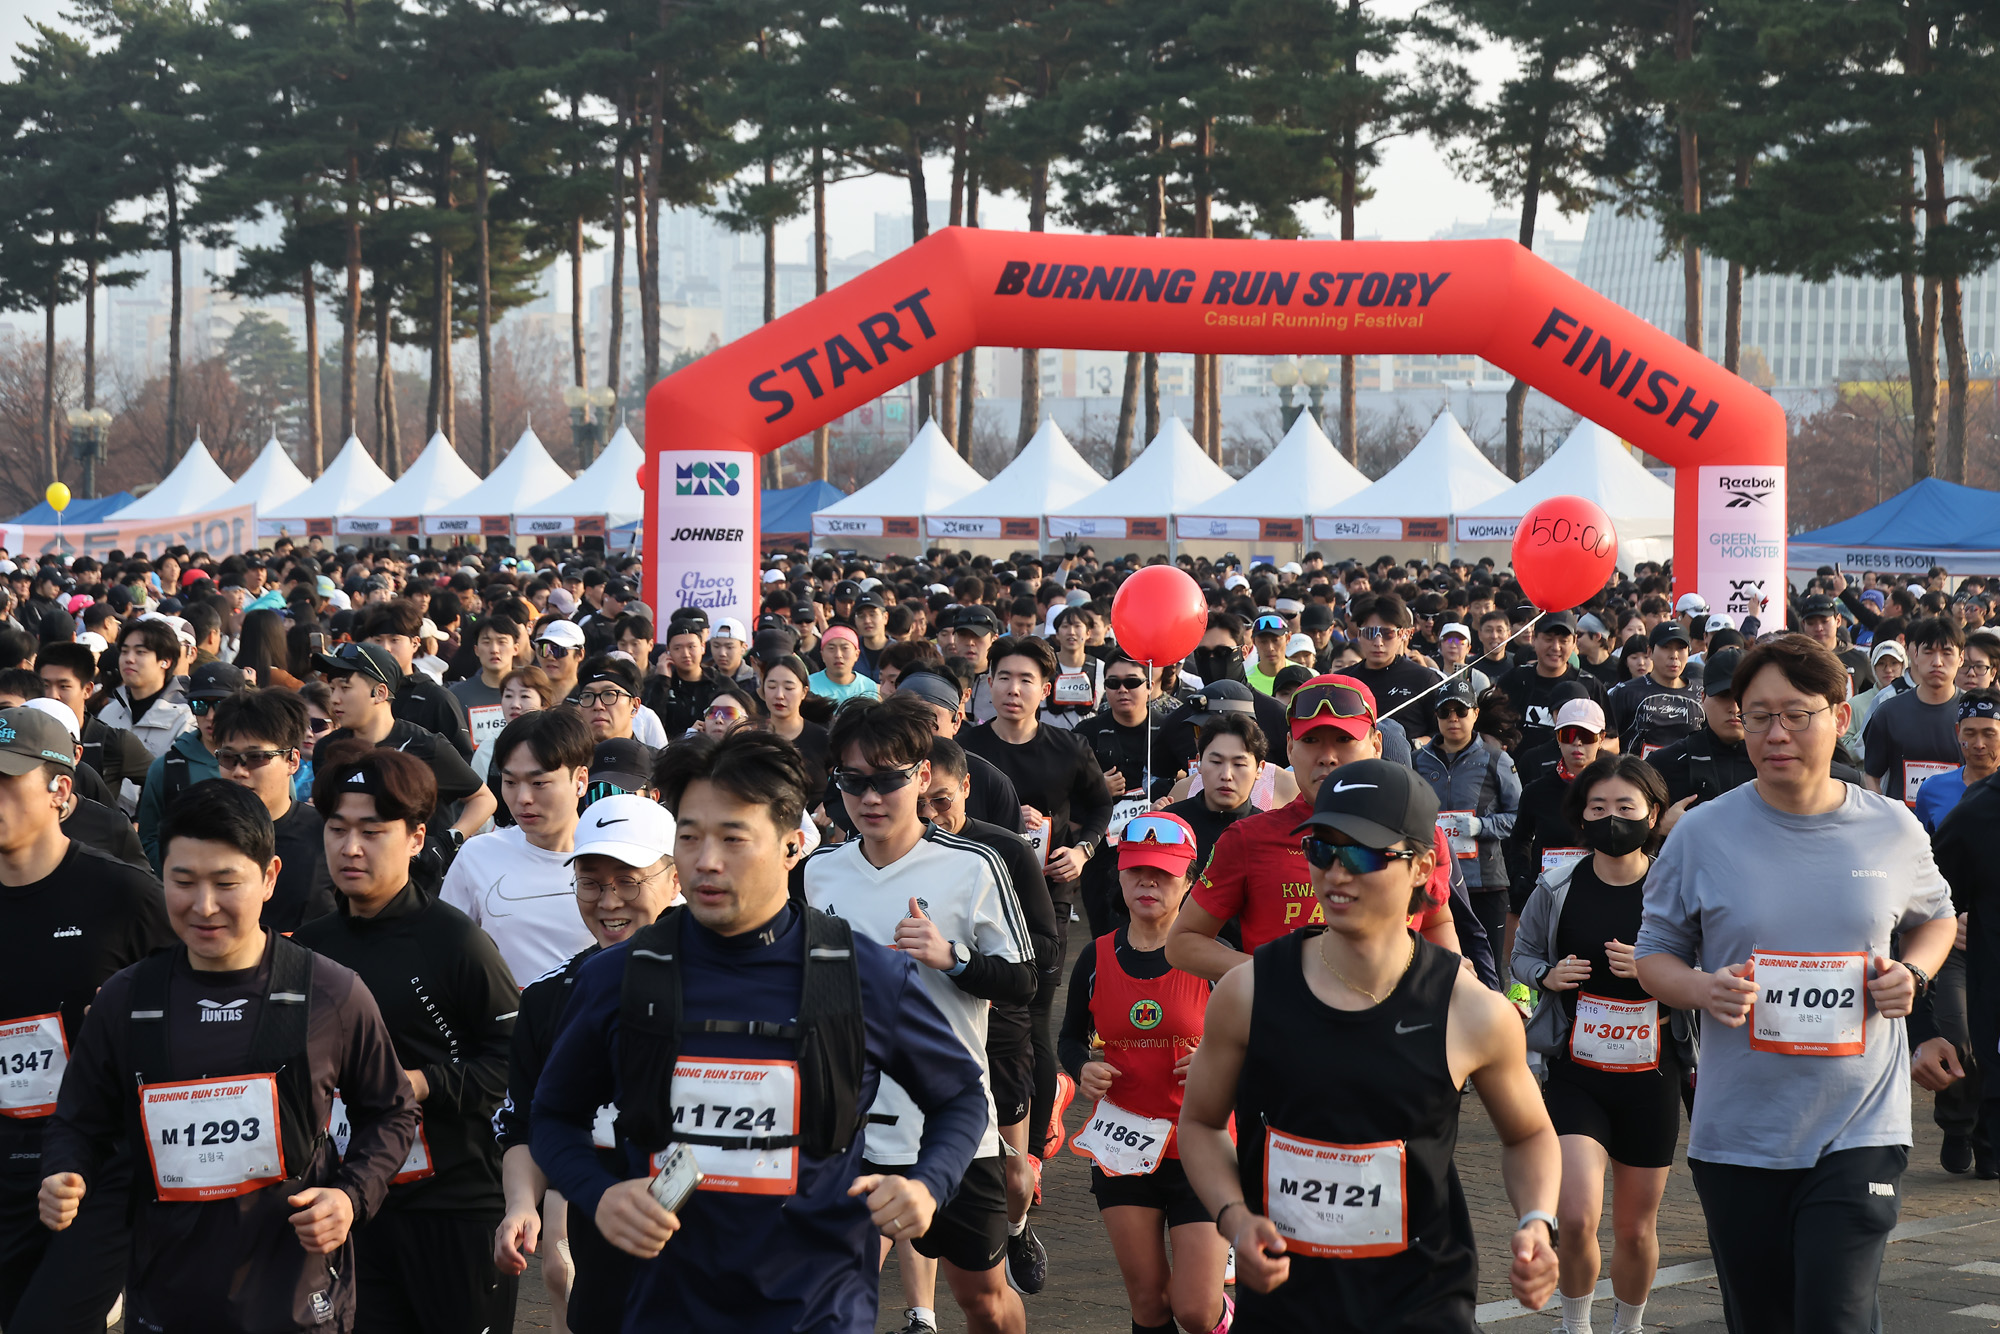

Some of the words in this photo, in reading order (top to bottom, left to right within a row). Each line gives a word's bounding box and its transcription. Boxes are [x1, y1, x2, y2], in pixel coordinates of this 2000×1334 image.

[995, 261, 1196, 304] BURNING
[1202, 270, 1300, 306] RUN
[1303, 271, 1451, 307] STORY
[1204, 311, 1266, 328] Casual
[1272, 312, 1348, 331] Running
[1354, 313, 1424, 329] Festival
[748, 288, 936, 424] START
[1086, 366, 1112, 390] 13
[1532, 307, 1719, 440] FINISH
[1720, 477, 1775, 488] Reebok
[670, 528, 744, 542] JOHNBER
[1469, 526, 1507, 536] WOMAN
[1532, 516, 1611, 559] 50:00
[1710, 533, 1756, 545] GREEN
[1721, 546, 1779, 558] MONSTER
[1846, 554, 1890, 567] PRESS
[1896, 555, 1936, 568] ROOM
[680, 571, 734, 590] Choco
[676, 588, 737, 609] Health
[1727, 604, 1767, 613] REY
[477, 718, 507, 729] M165
[1759, 959, 1798, 968] BURNING
[1766, 987, 1855, 1008] M1002
[200, 1009, 243, 1022] JUNTAS
[16, 1024, 40, 1034] STORY
[1758, 1028, 1780, 1037] 10km
[1576, 1050, 1593, 1058] 10km
[704, 1070, 728, 1080] RUN
[728, 1071, 768, 1081] STORY
[148, 1092, 188, 1104] BURNING
[191, 1090, 212, 1099] RUN
[214, 1085, 248, 1096] STORY
[162, 1117, 260, 1147] M1293
[1273, 1140, 1313, 1156] BURNING
[1316, 1150, 1338, 1160] RUN
[1340, 1153, 1375, 1163] STORY
[162, 1174, 184, 1183] 10km
[1280, 1178, 1382, 1207] M2121
[1869, 1182, 1895, 1196] PUMA
